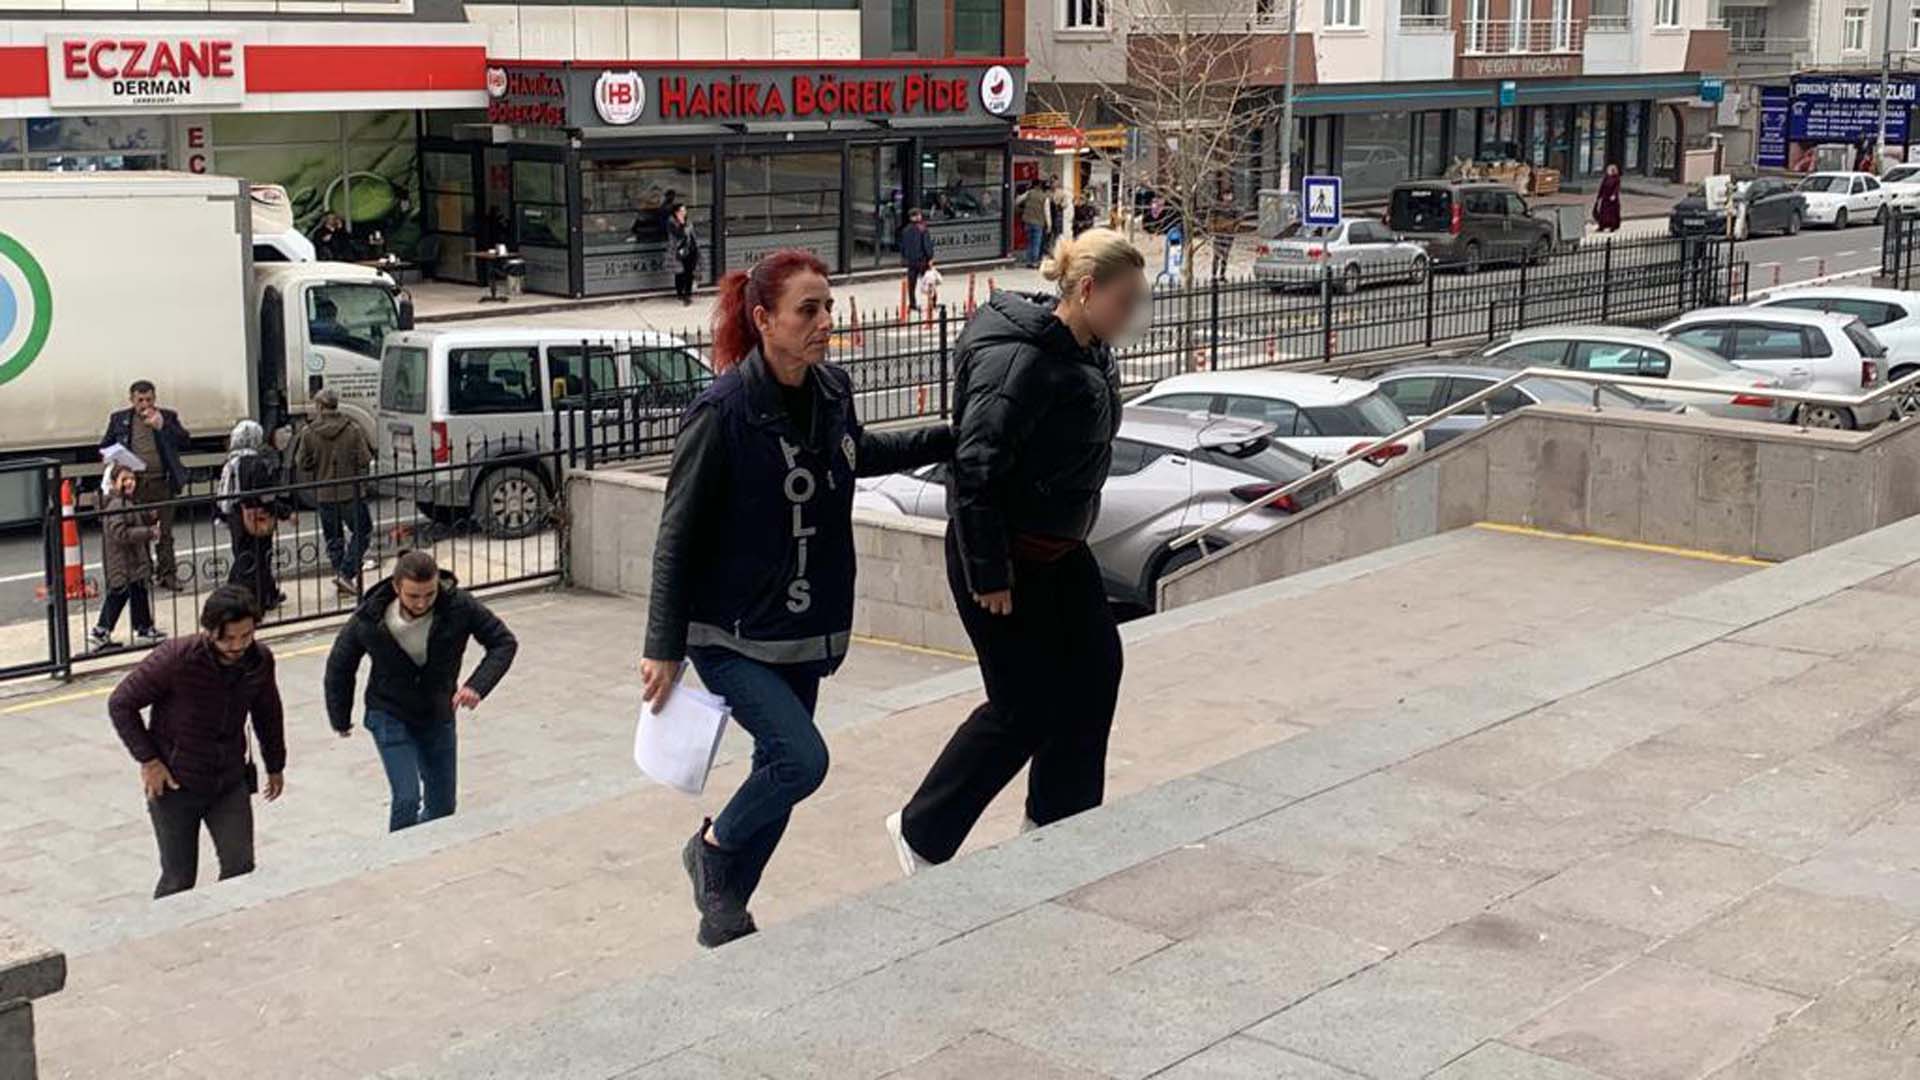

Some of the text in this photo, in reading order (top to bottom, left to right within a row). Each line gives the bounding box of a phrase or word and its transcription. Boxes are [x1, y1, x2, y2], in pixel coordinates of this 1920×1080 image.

[63, 40, 235, 80] ECZANE
[113, 80, 191, 96] DERMAN
[608, 83, 632, 106] HB
[659, 73, 969, 119] HARİKA BÖREK PİDE
[1863, 83, 1916, 99] CİHZLARI
